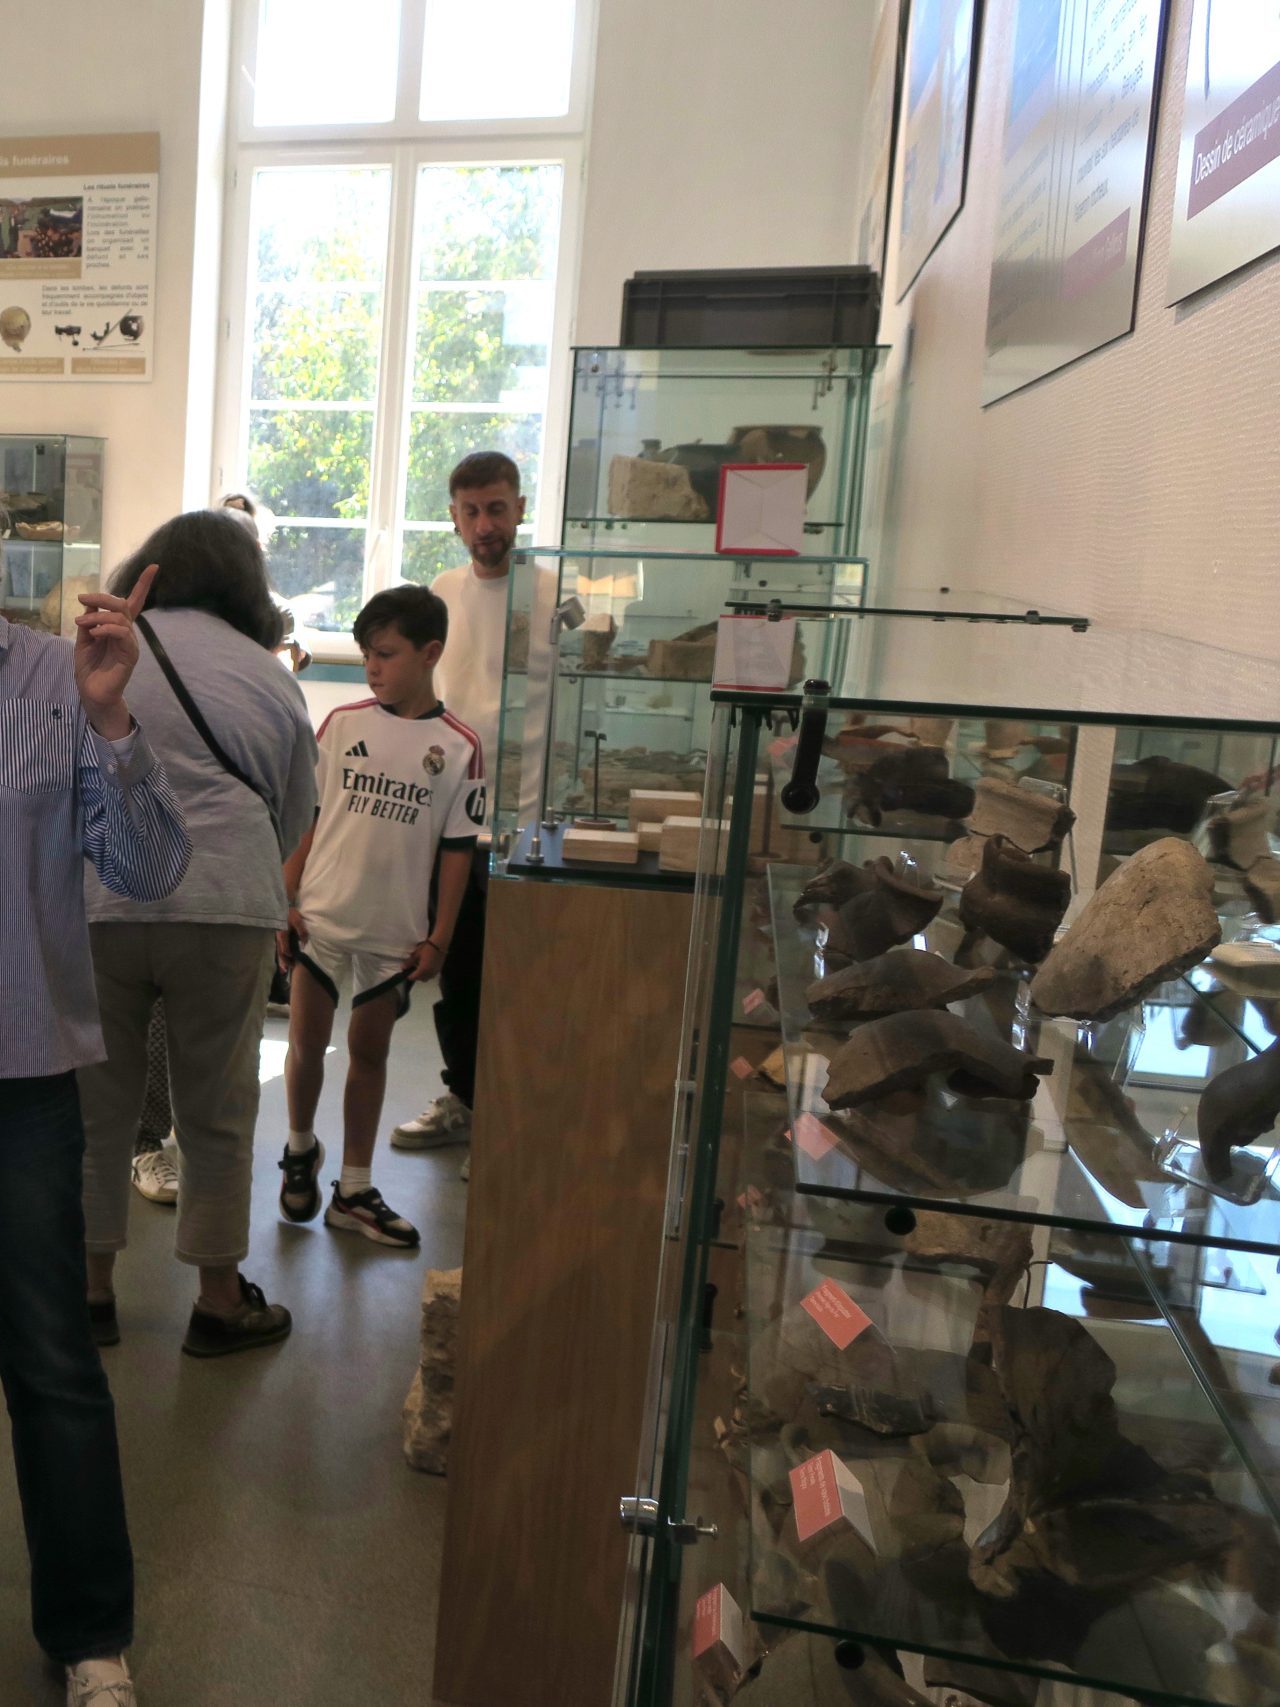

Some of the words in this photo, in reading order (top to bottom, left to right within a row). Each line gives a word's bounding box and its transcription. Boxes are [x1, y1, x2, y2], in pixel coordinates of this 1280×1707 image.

[13, 154, 69, 166] funéraires
[1194, 139, 1221, 185] Dessin
[1222, 129, 1233, 164] de
[343, 768, 433, 806] Emirates
[348, 794, 368, 812] FLY
[370, 801, 420, 826] BETTER
